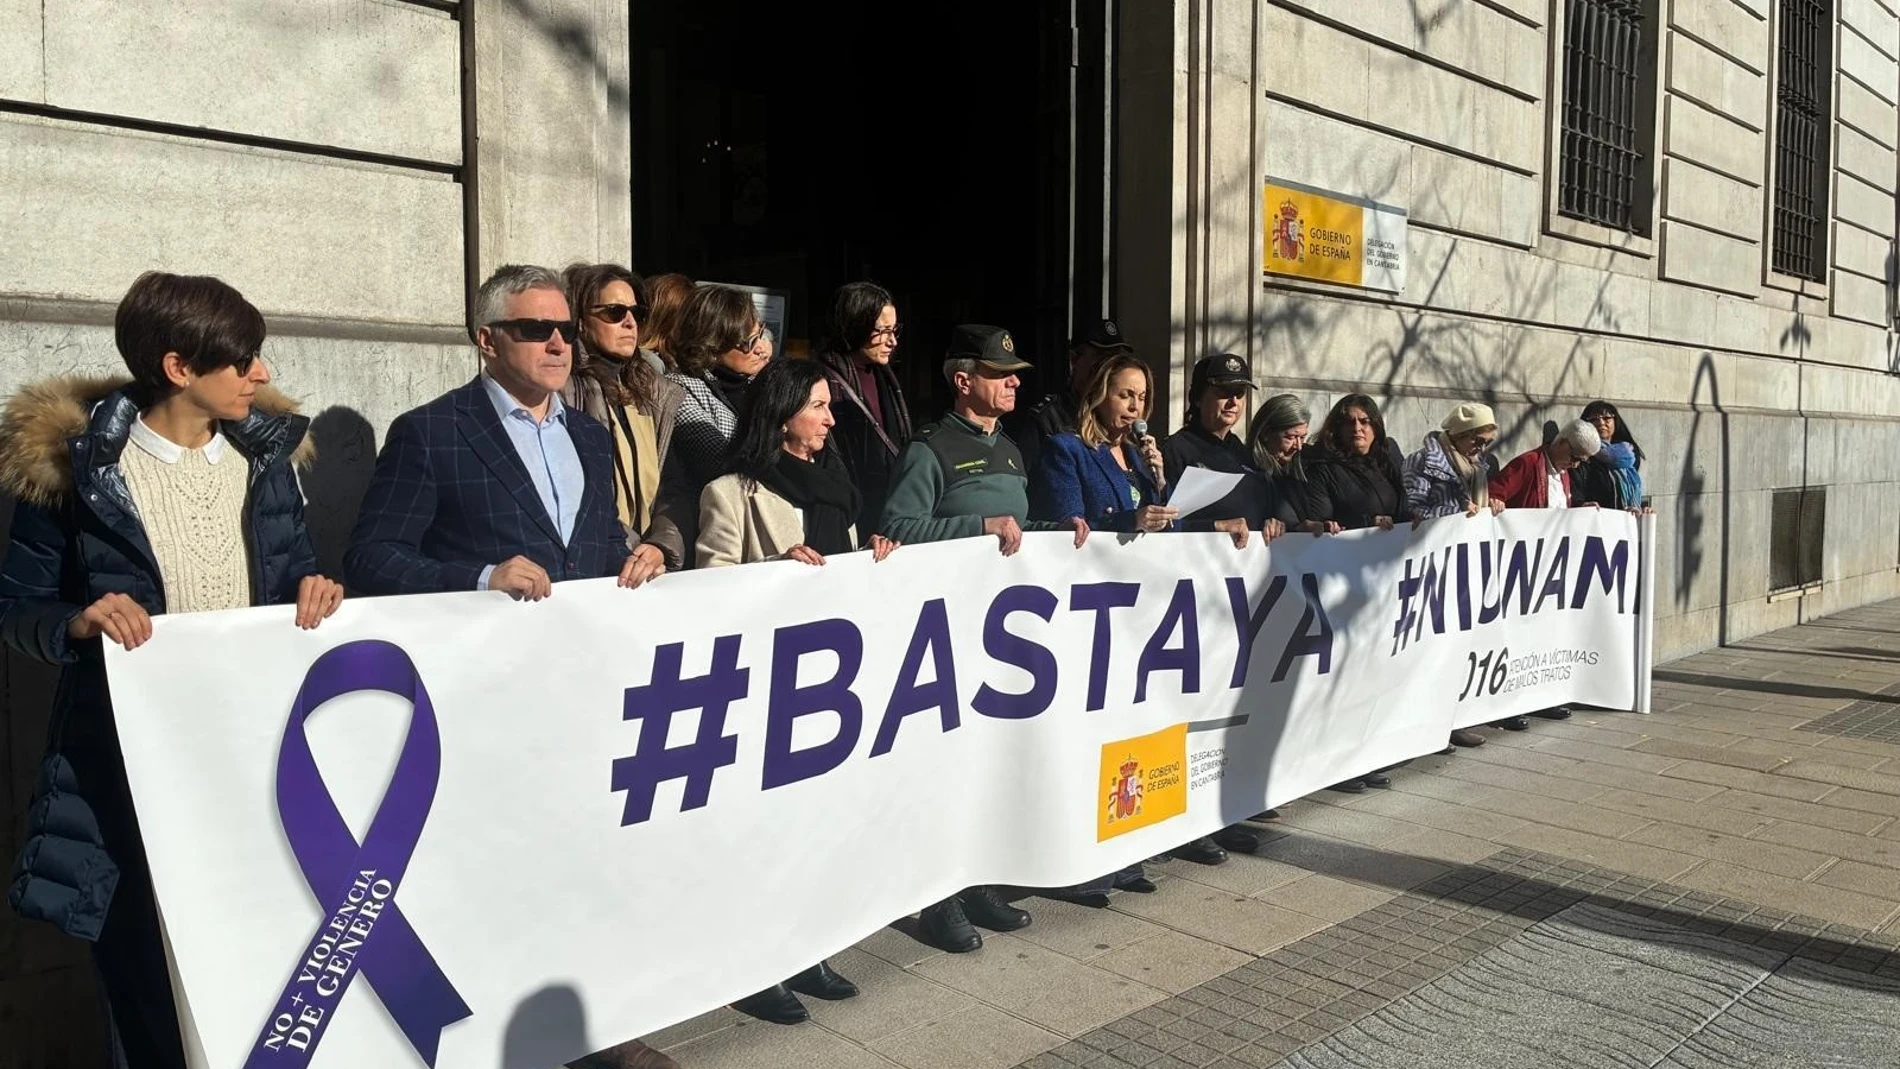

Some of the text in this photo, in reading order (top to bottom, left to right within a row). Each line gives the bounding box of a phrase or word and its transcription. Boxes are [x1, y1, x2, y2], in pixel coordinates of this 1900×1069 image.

[1310, 227, 1351, 245] GOBIERNO
[1309, 243, 1351, 261] DE ESPAÑA
[1367, 248, 1400, 261] DEL GOBIERNO
[1374, 259, 1400, 270] CANTABRIA
[1509, 648, 1599, 676] ATENCIÓN A VÍCTIMAS
[1503, 679, 1515, 693] DE
[1540, 665, 1572, 683] TRATOS
[1149, 760, 1180, 780] GOBIERNO
[1191, 757, 1229, 777] DEL GOBIERNO
[1147, 774, 1180, 793] DE ESPAÑA
[1191, 770, 1226, 791] EN CANTABRIA
[264, 868, 378, 1053] NO + VIOLENCIA
[285, 878, 393, 1054] DE GENERO
